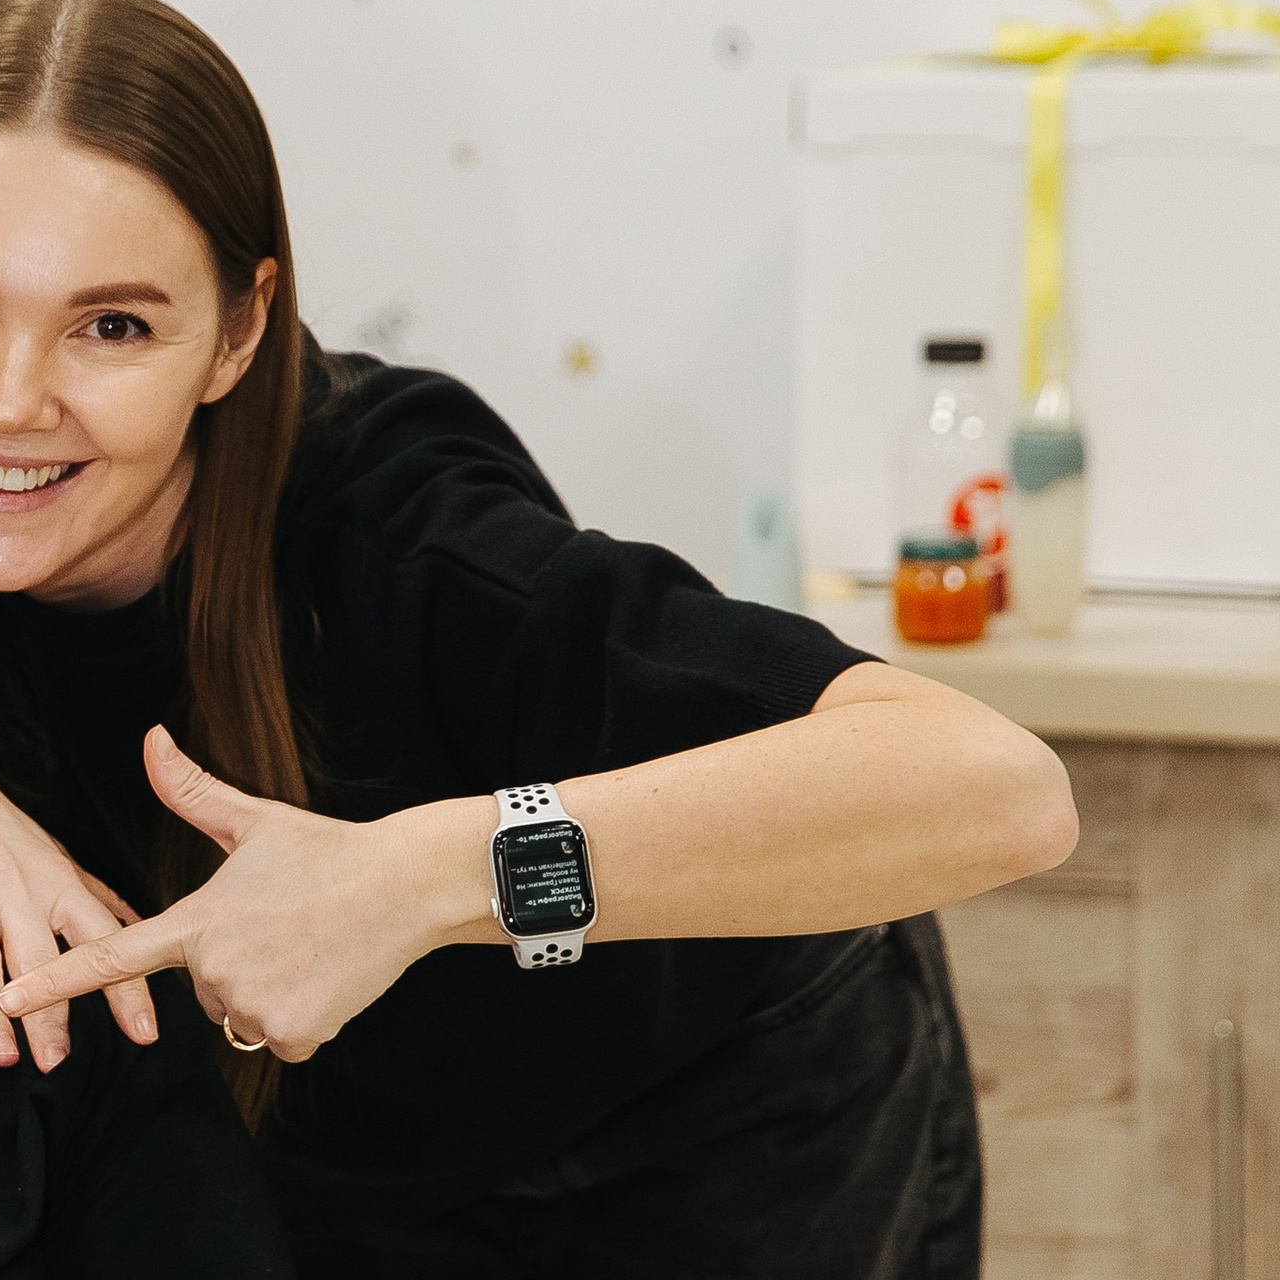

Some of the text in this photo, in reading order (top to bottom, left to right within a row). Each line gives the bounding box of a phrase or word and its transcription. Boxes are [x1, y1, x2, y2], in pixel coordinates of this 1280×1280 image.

[529, 830, 573, 841] Видеографы
[542, 869, 569, 878] вообще
[558, 877, 580, 885] Павел
[537, 893, 582, 904] Видеографы
